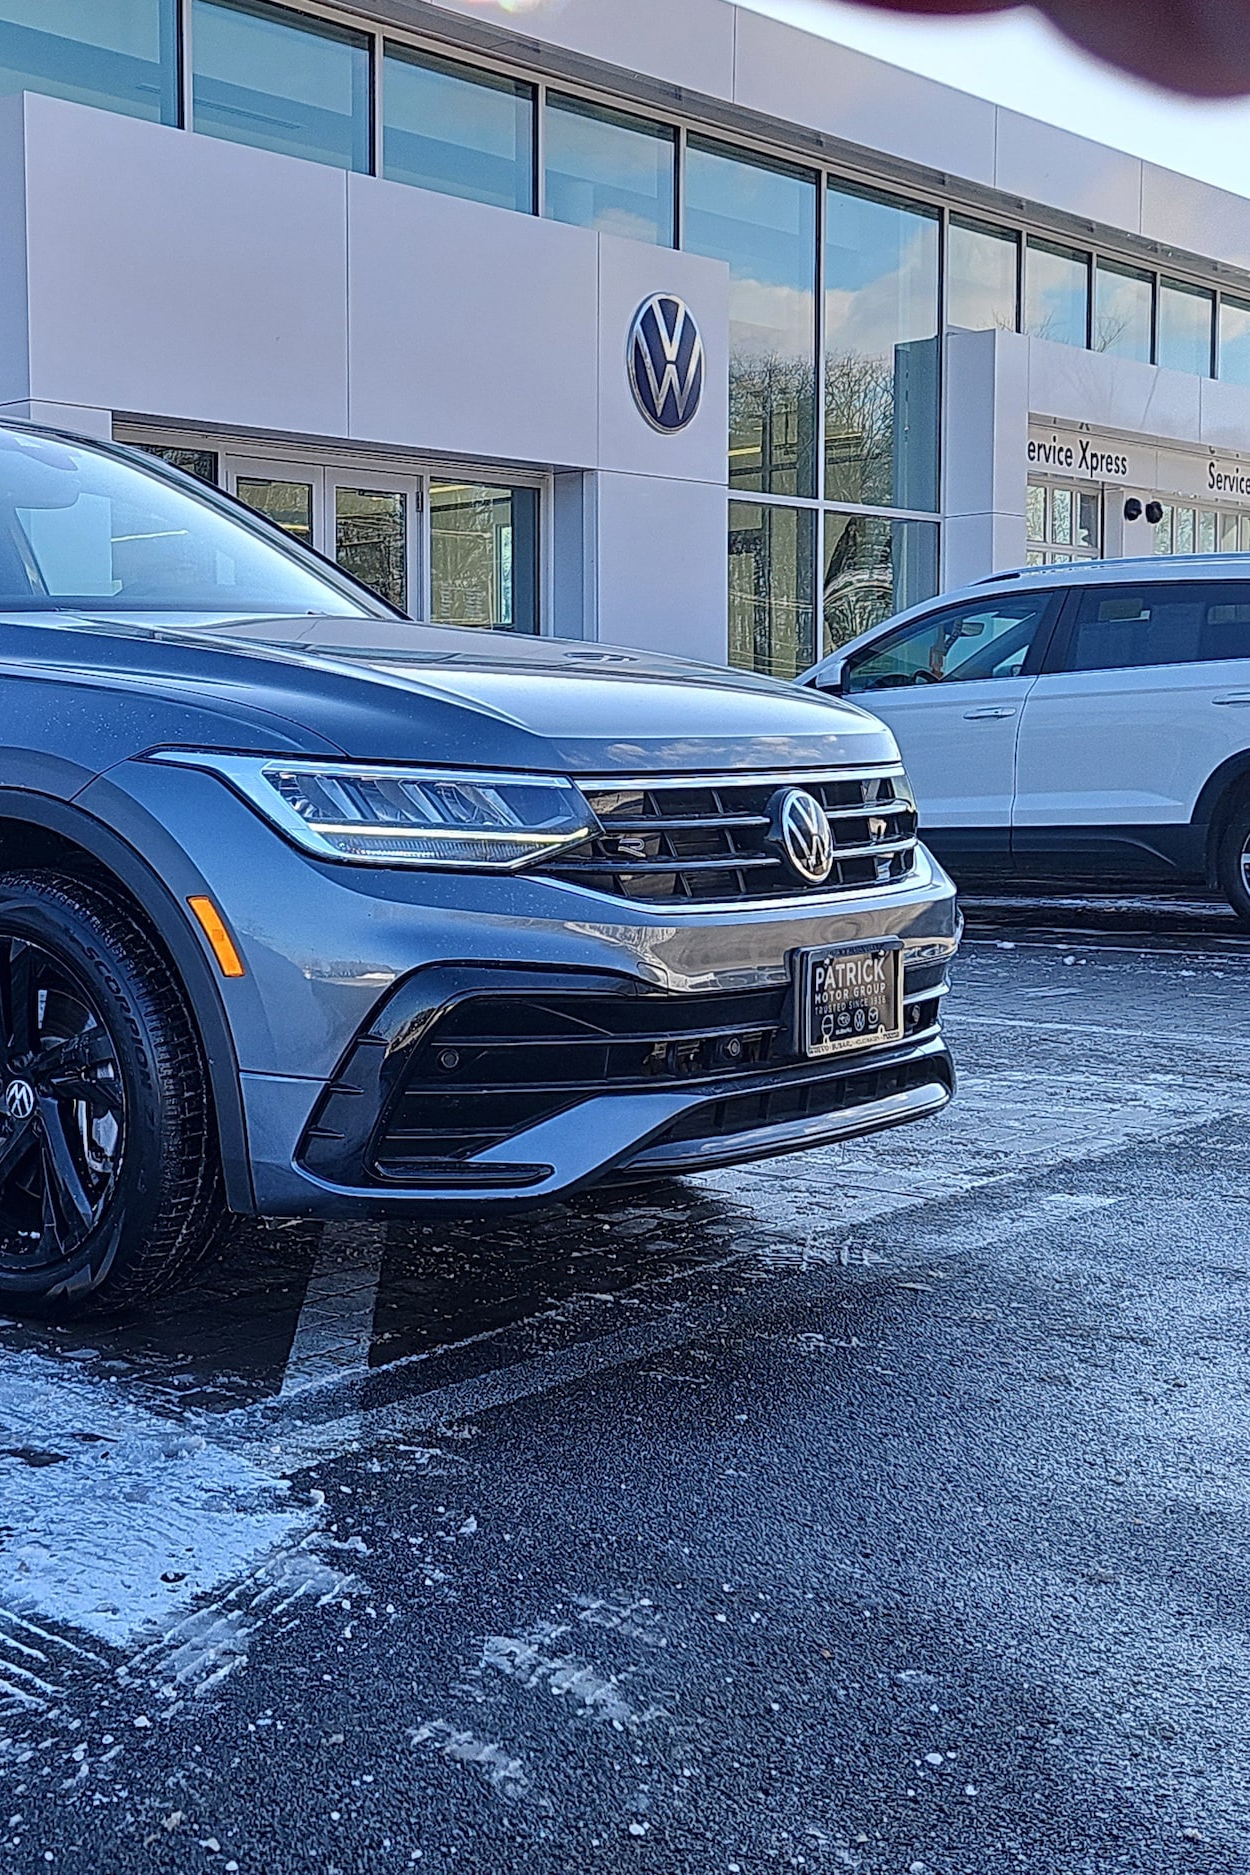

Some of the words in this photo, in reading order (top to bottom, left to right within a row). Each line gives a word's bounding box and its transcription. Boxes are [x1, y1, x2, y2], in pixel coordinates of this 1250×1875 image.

[1027, 434, 1073, 468] ervice
[1077, 438, 1128, 478] Xpress
[815, 957, 886, 992] PATRICK
[814, 989, 849, 1005] MOTOR
[853, 982, 886, 998] GROUP
[814, 1002, 847, 1016] TRUSTED
[848, 998, 869, 1010] SINCE
